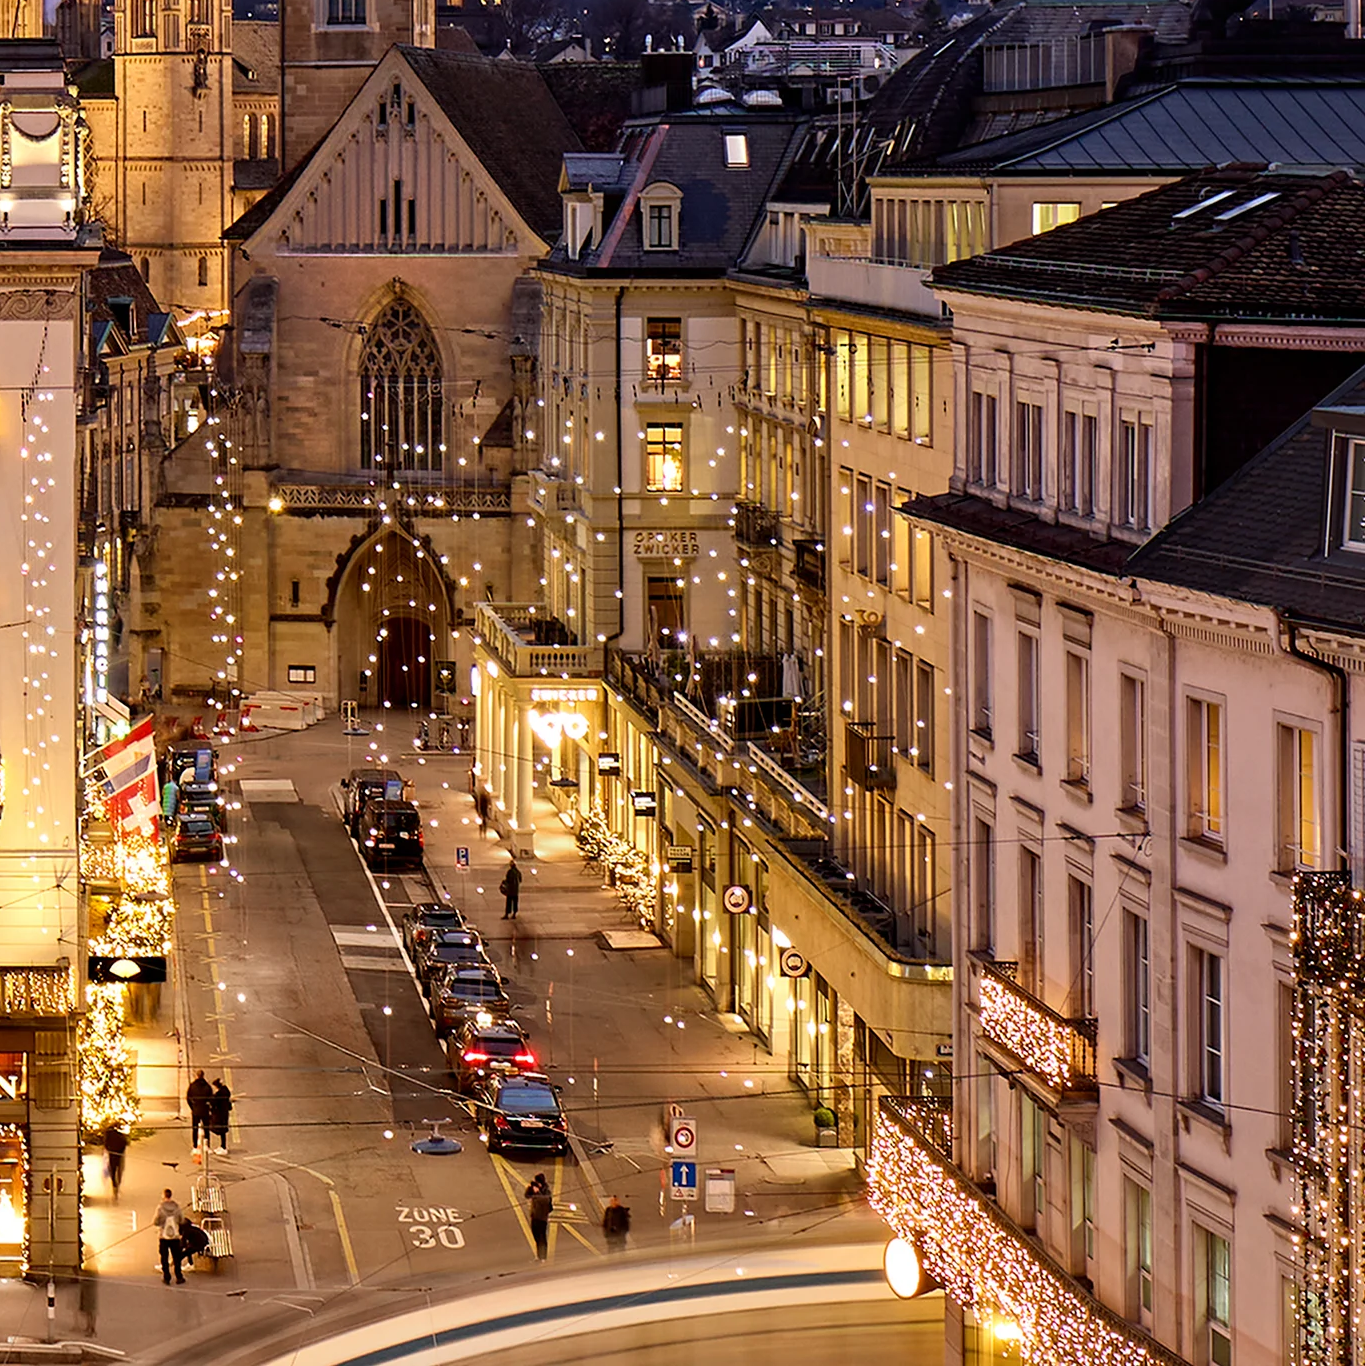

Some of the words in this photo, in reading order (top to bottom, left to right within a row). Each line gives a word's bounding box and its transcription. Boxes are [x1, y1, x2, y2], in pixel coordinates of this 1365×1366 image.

[634, 544, 700, 555] ZWICKER
[459, 848, 466, 860] P
[395, 1206, 464, 1223] ZONE
[409, 1225, 466, 1249] 30
